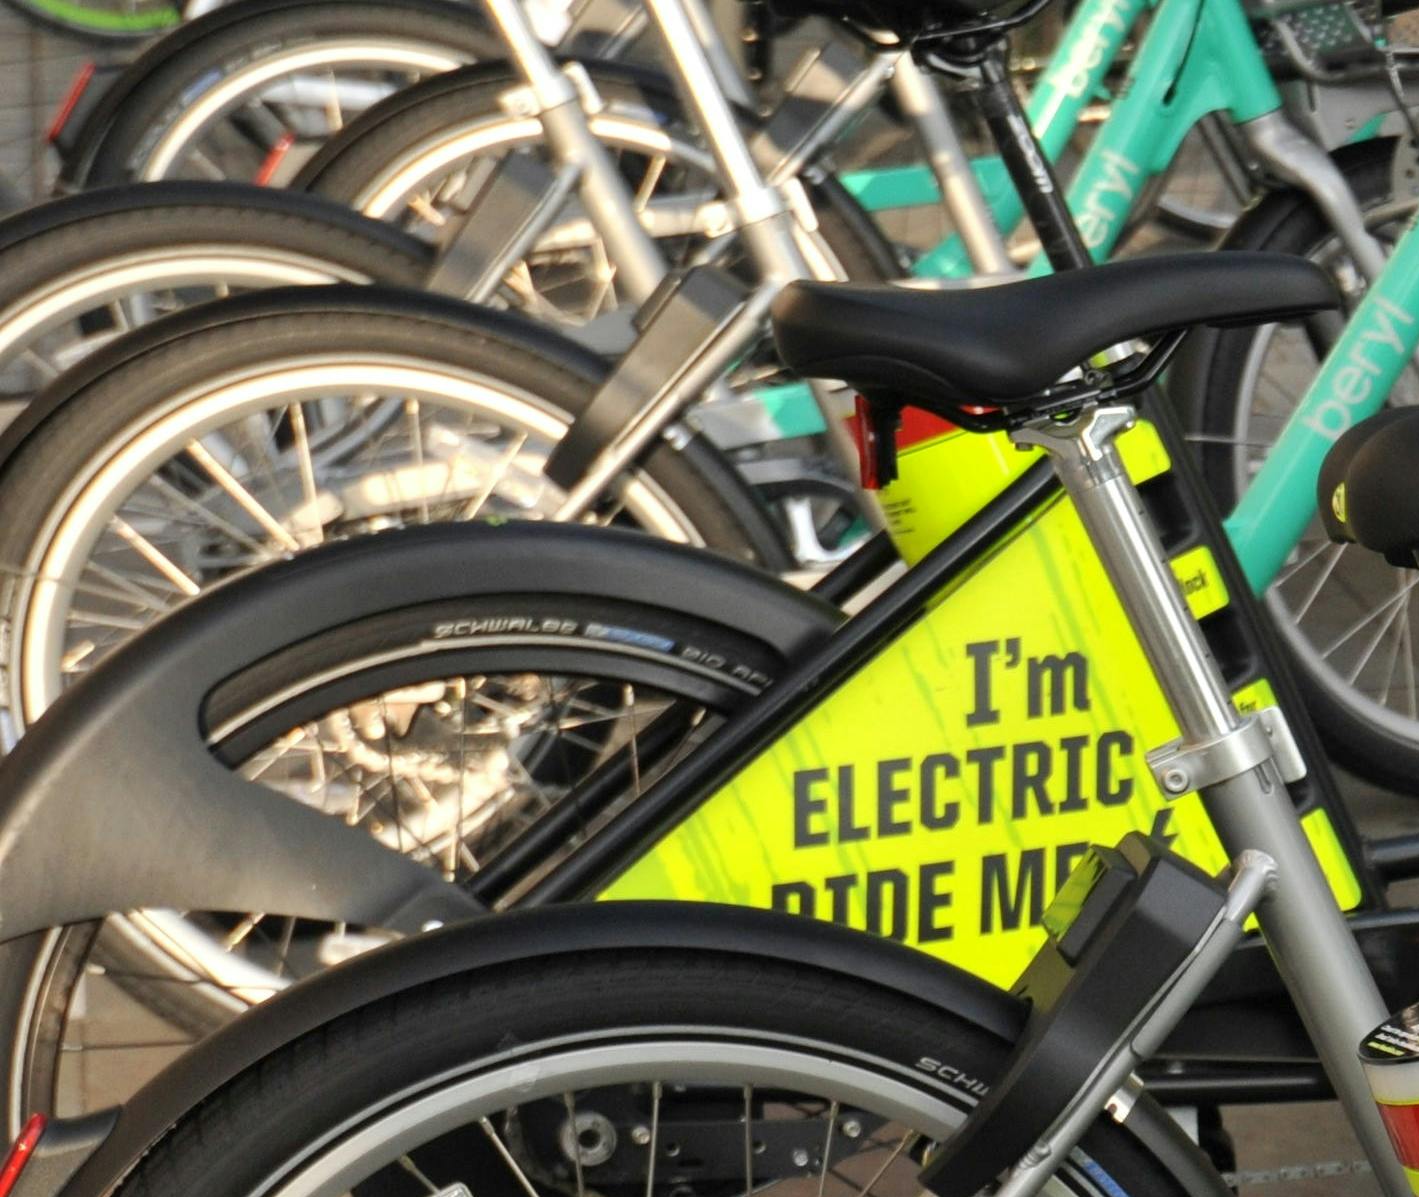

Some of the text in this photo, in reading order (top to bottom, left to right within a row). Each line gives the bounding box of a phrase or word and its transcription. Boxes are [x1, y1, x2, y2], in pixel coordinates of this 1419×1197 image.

[1049, 0, 1130, 98] bery
[1076, 149, 1140, 248] eryl
[1302, 296, 1415, 442] beryl
[965, 637, 1091, 728] I'm
[793, 730, 1134, 850] ELECTRIC
